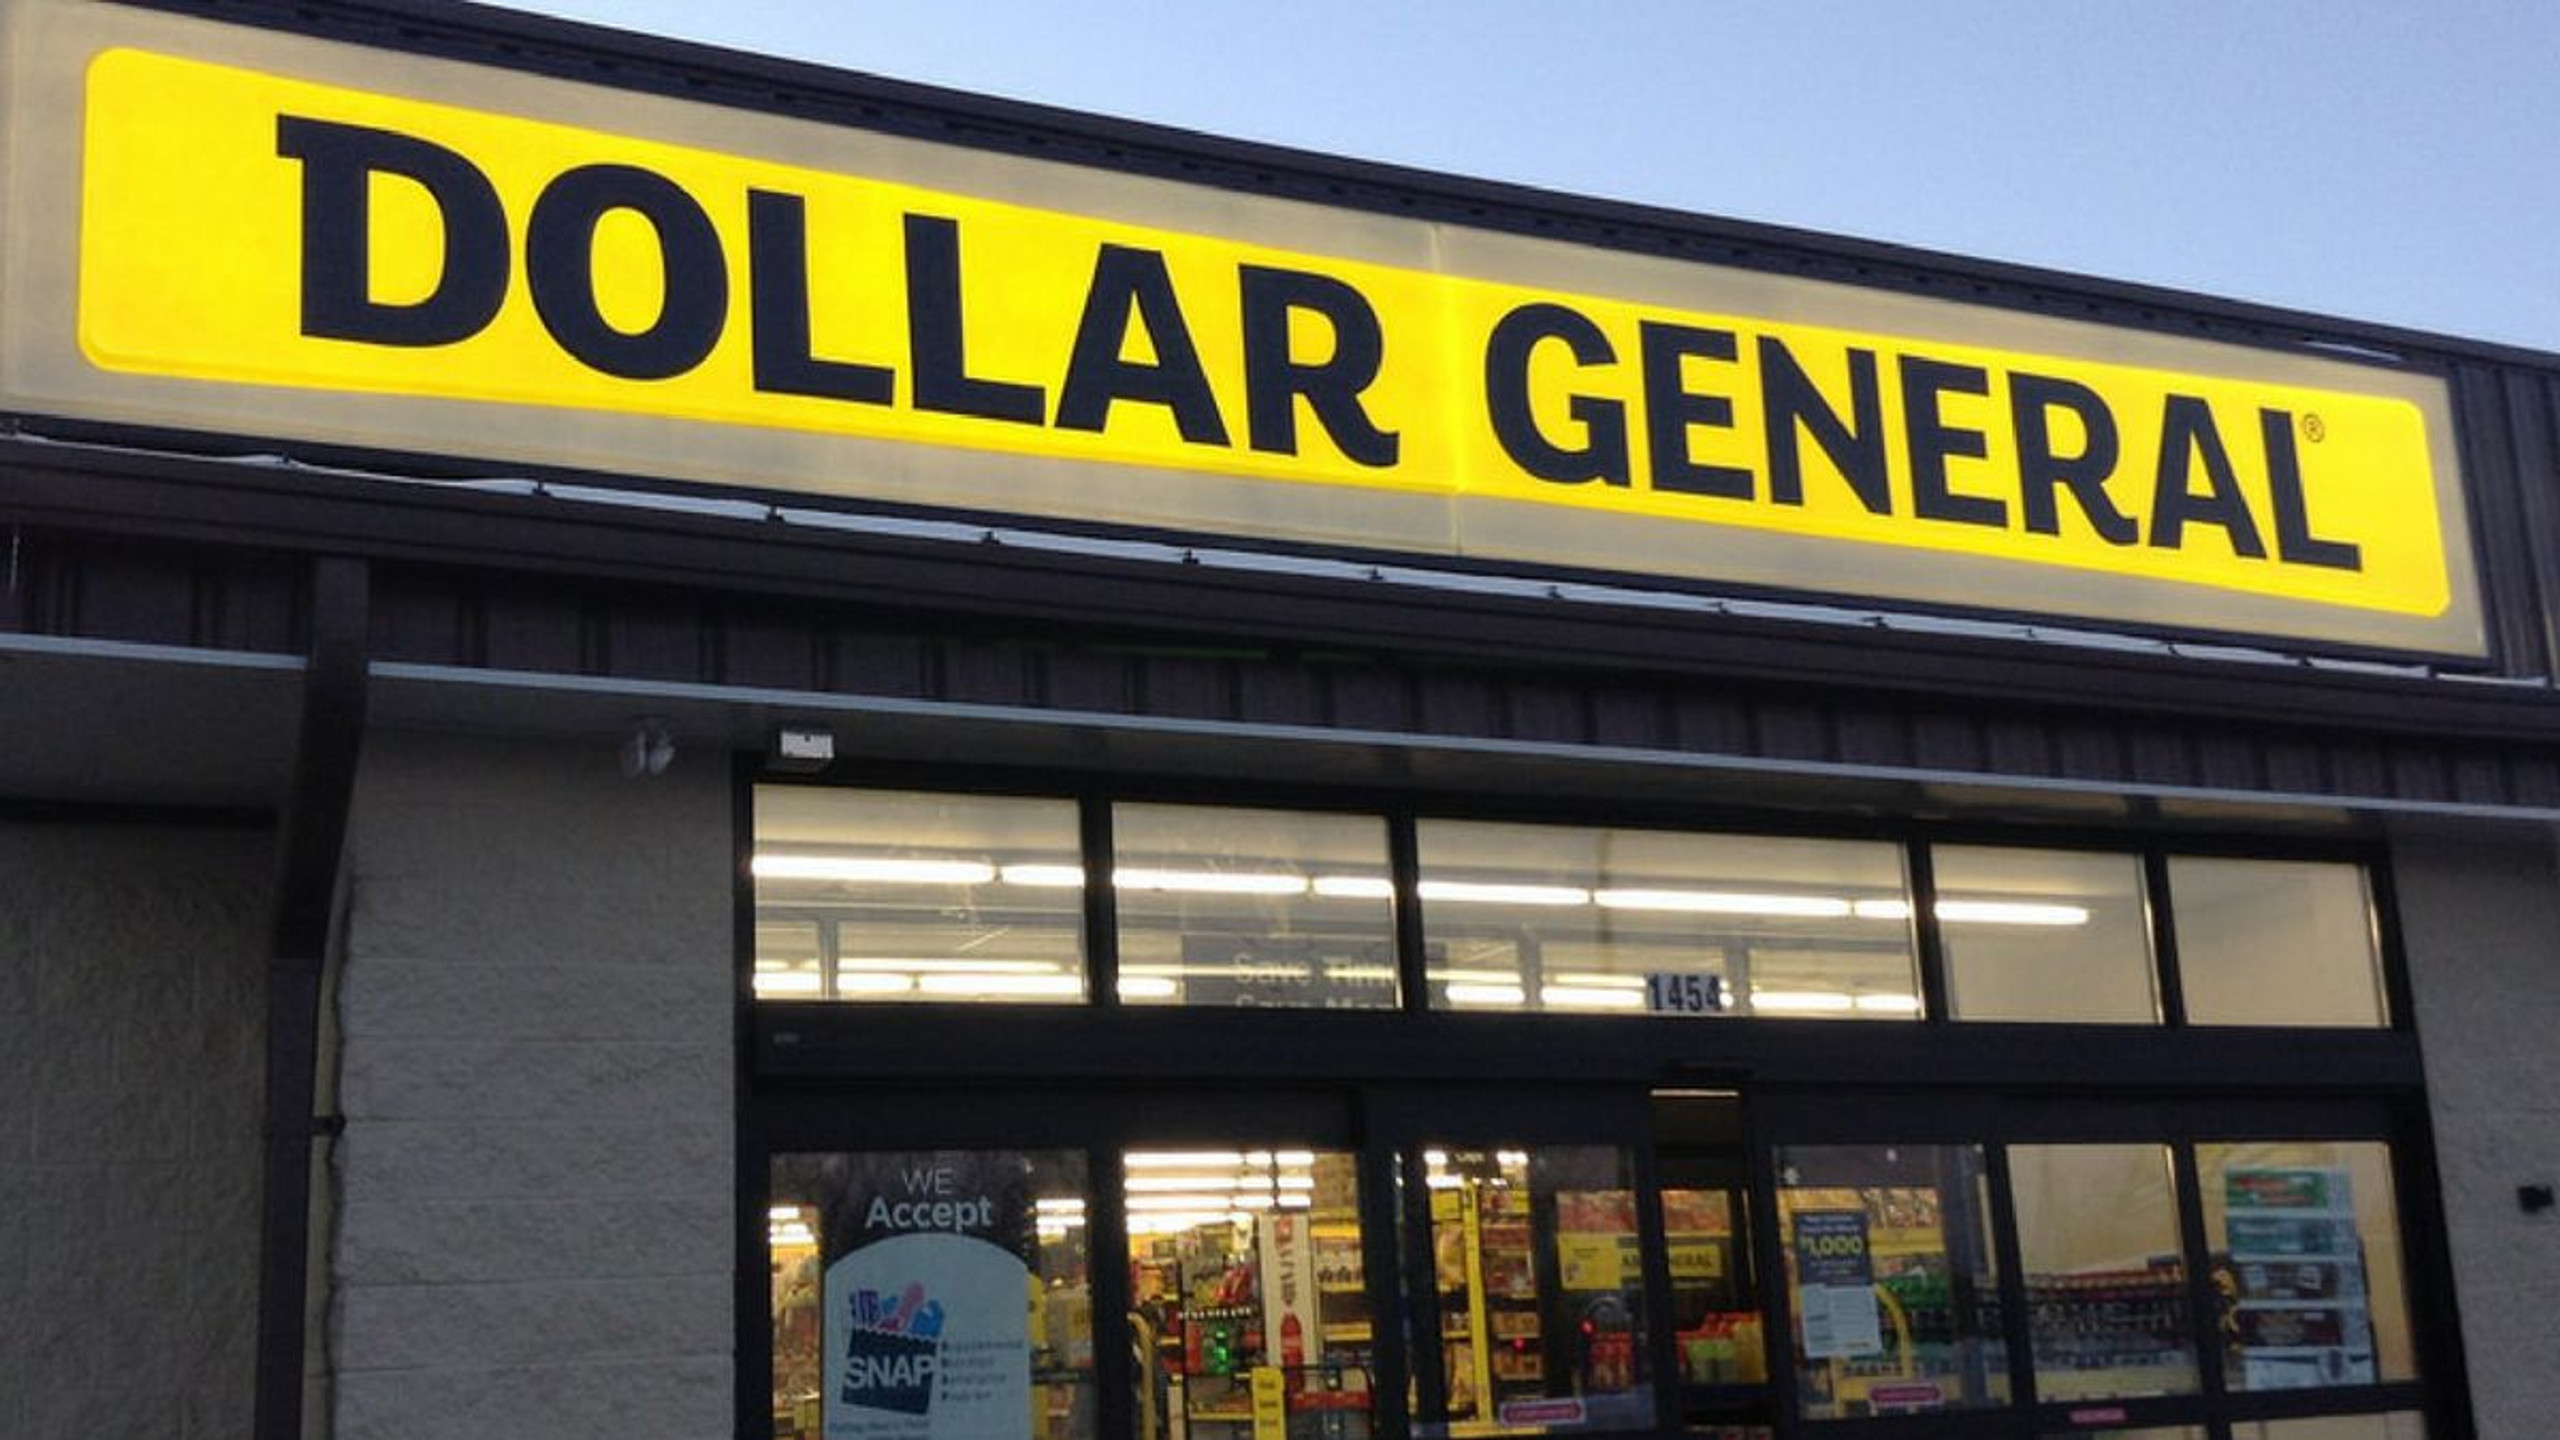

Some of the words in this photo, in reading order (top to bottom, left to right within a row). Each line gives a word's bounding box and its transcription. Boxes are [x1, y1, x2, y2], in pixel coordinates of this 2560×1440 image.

[277, 114, 1399, 468] DOLLAR
[1485, 303, 2361, 571] GENERAL
[1235, 953, 1312, 988] Save
[1646, 973, 1722, 1012] 1454
[901, 1167, 954, 1195] WE
[864, 1195, 993, 1233] Accept
[844, 1353, 935, 1391] SNAP
